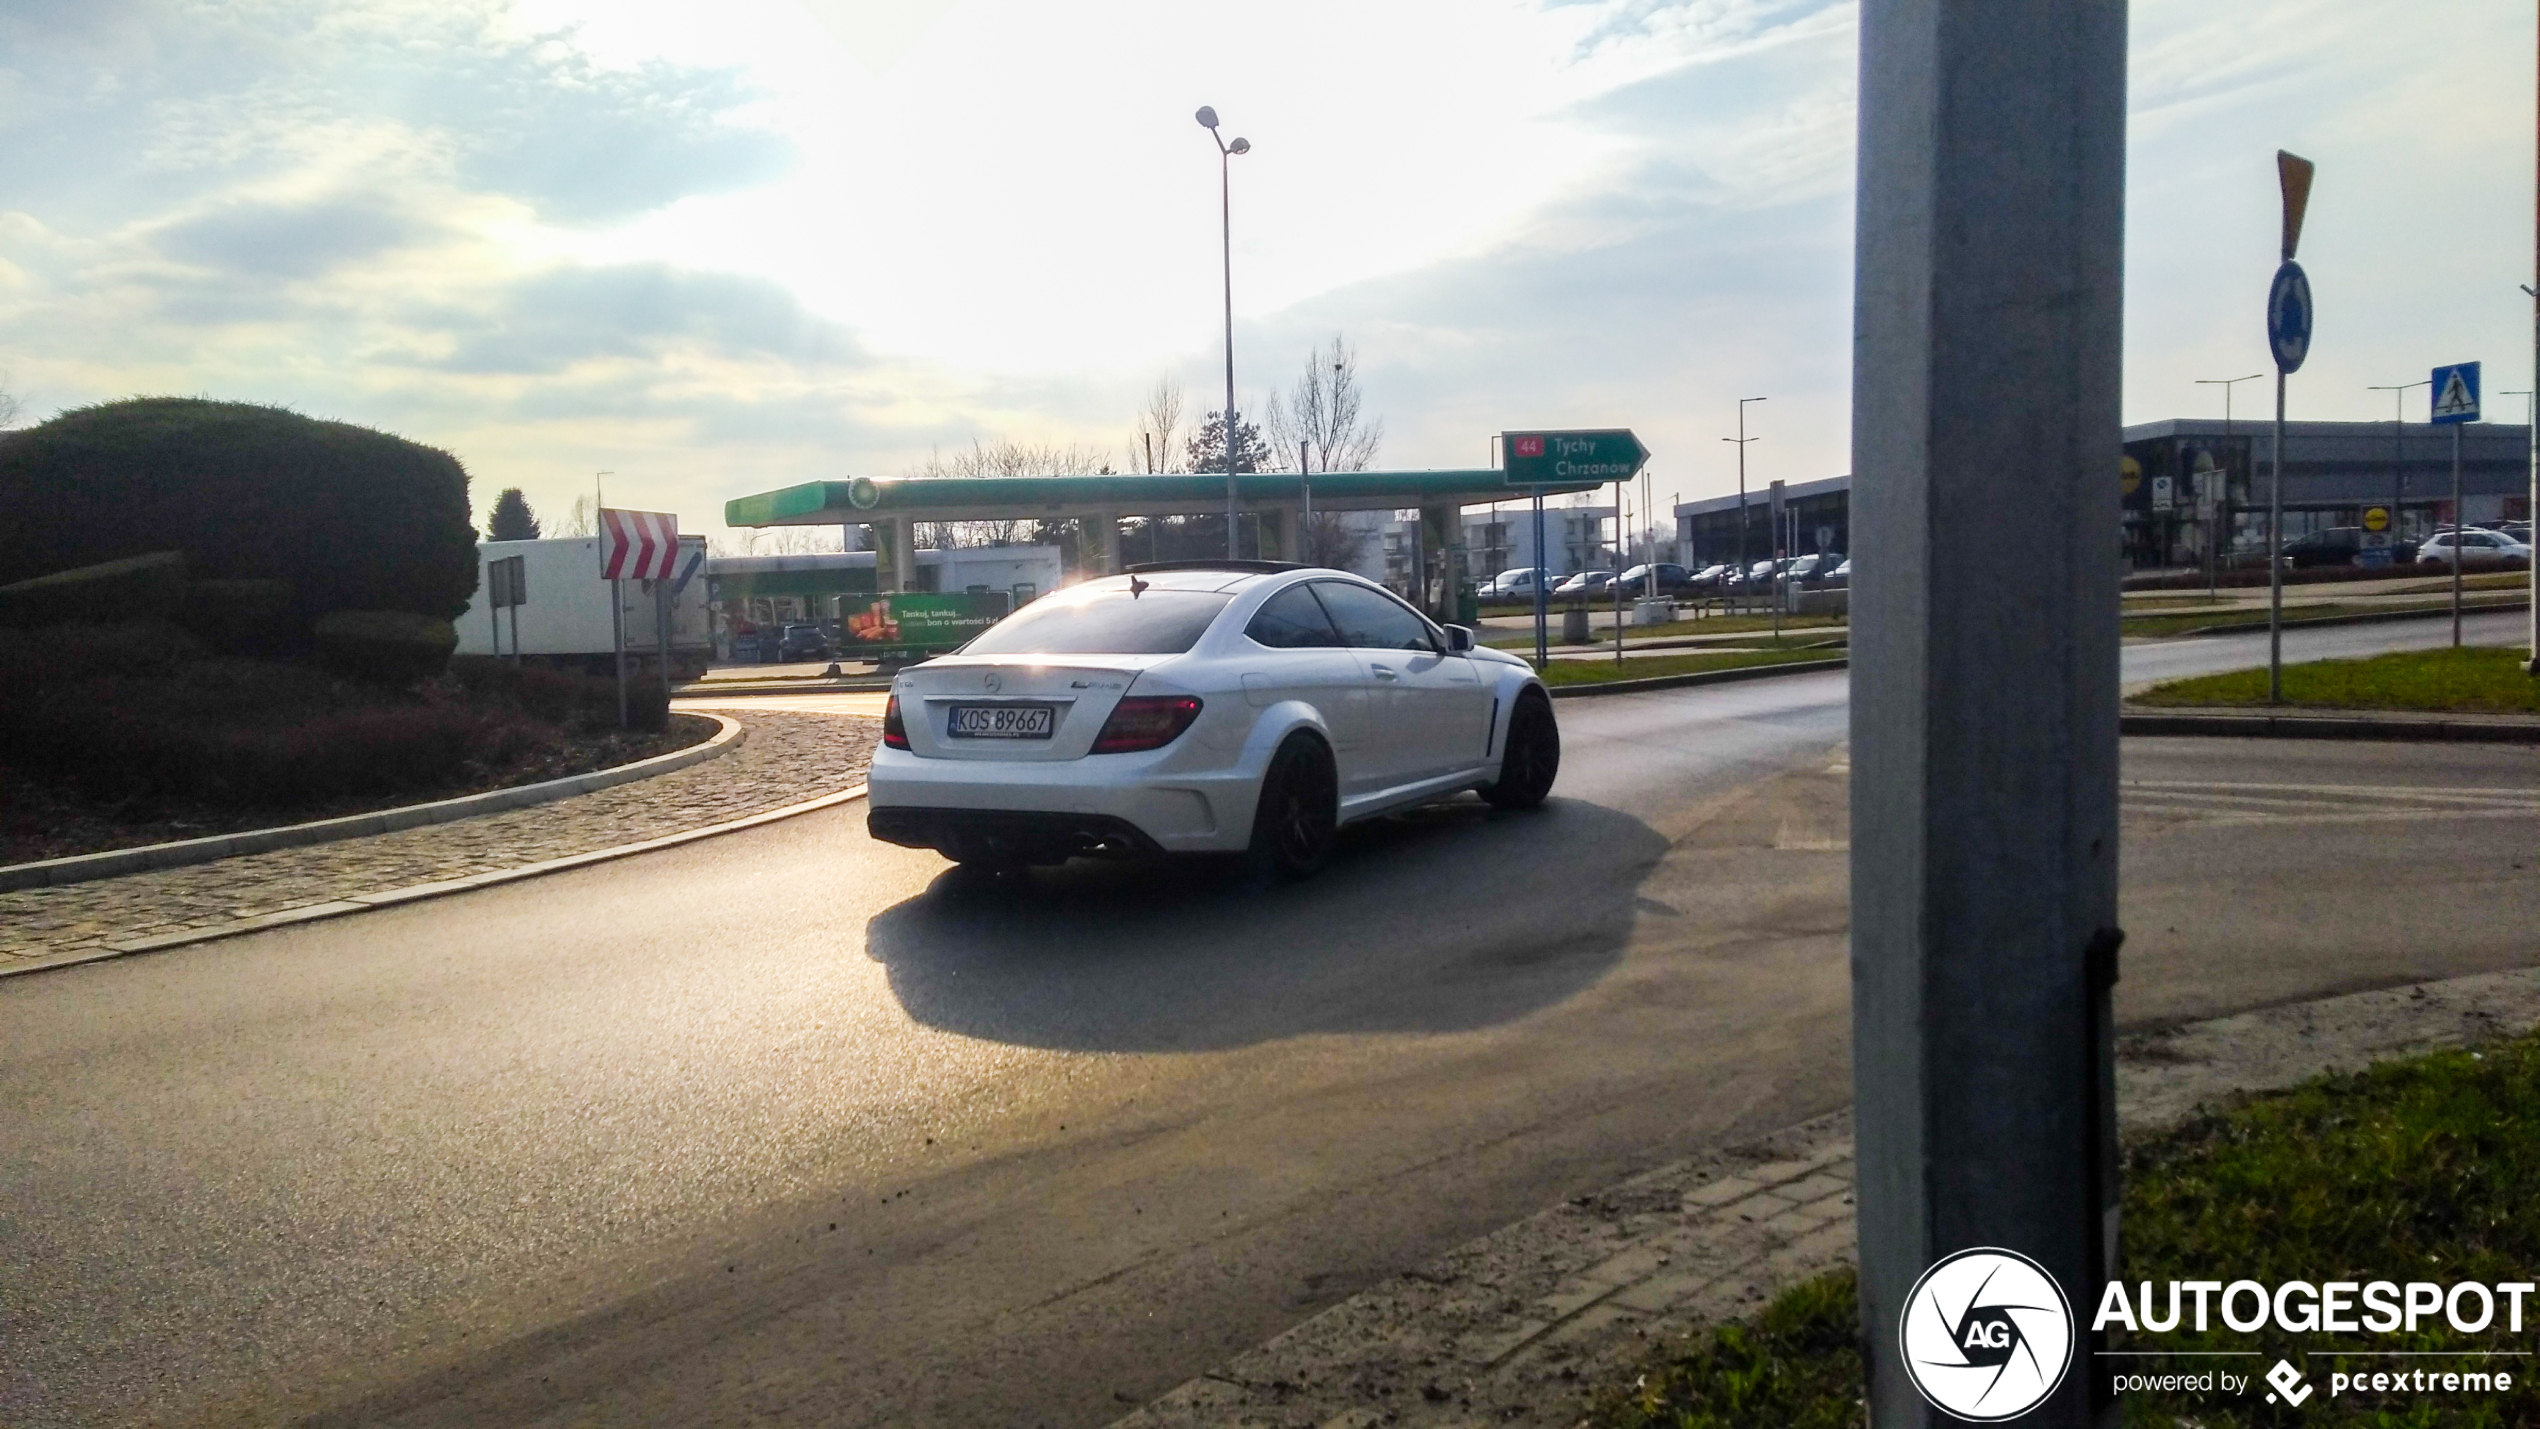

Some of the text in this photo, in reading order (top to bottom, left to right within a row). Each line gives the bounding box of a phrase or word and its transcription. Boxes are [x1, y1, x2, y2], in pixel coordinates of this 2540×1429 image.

[1520, 438, 1596, 456] 44 Tychy
[1555, 461, 1630, 475] Chrzanów
[902, 610, 929, 618] Tankuj,
[951, 617, 984, 626] wartości
[985, 617, 991, 625] 5
[958, 710, 1049, 730] KOS 89667
